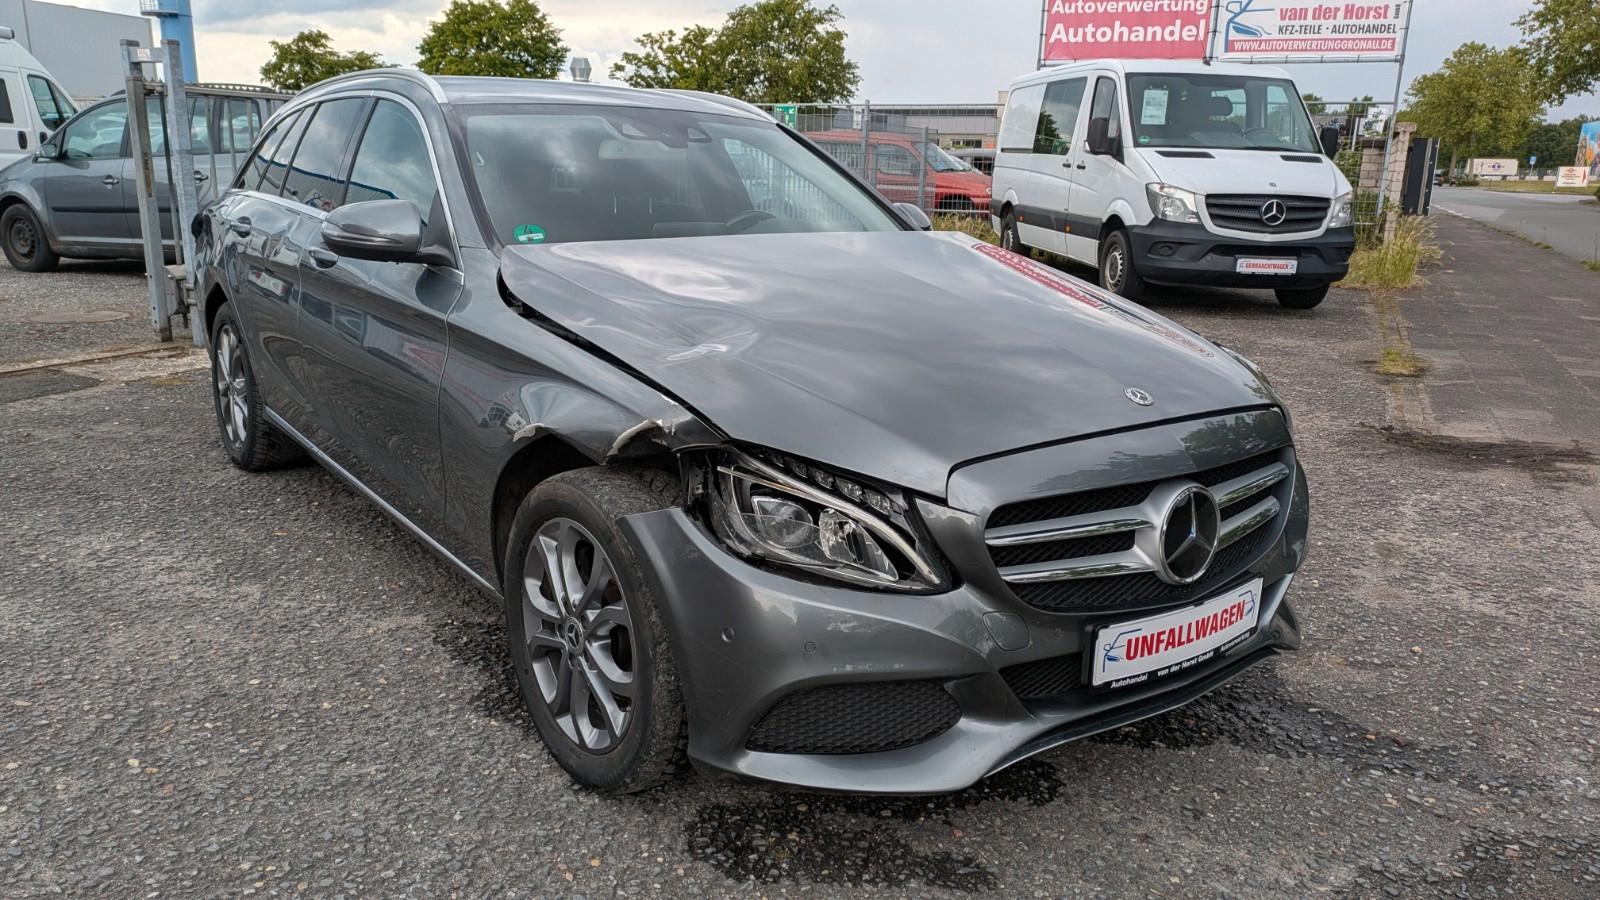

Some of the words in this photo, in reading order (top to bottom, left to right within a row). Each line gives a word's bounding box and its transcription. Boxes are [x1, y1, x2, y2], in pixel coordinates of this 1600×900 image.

[1051, 0, 1208, 14] Autoverwertung
[1279, 7, 1308, 21] van
[1312, 6, 1342, 21] der
[1343, 3, 1390, 20] Horst
[1049, 19, 1206, 43] Autohandel
[1278, 25, 1322, 35] KFZ-TEILE
[1330, 23, 1397, 34] AUTOHANDEL
[1234, 39, 1393, 51] WWW.AUTOVERWERTUNGGRONAU.DE
[1125, 599, 1246, 661] UNFALLWAGEN
[1111, 673, 1148, 689] Autohandel
[1157, 668, 1170, 677] van
[1170, 663, 1180, 673] der
[1181, 658, 1198, 669] Horst
